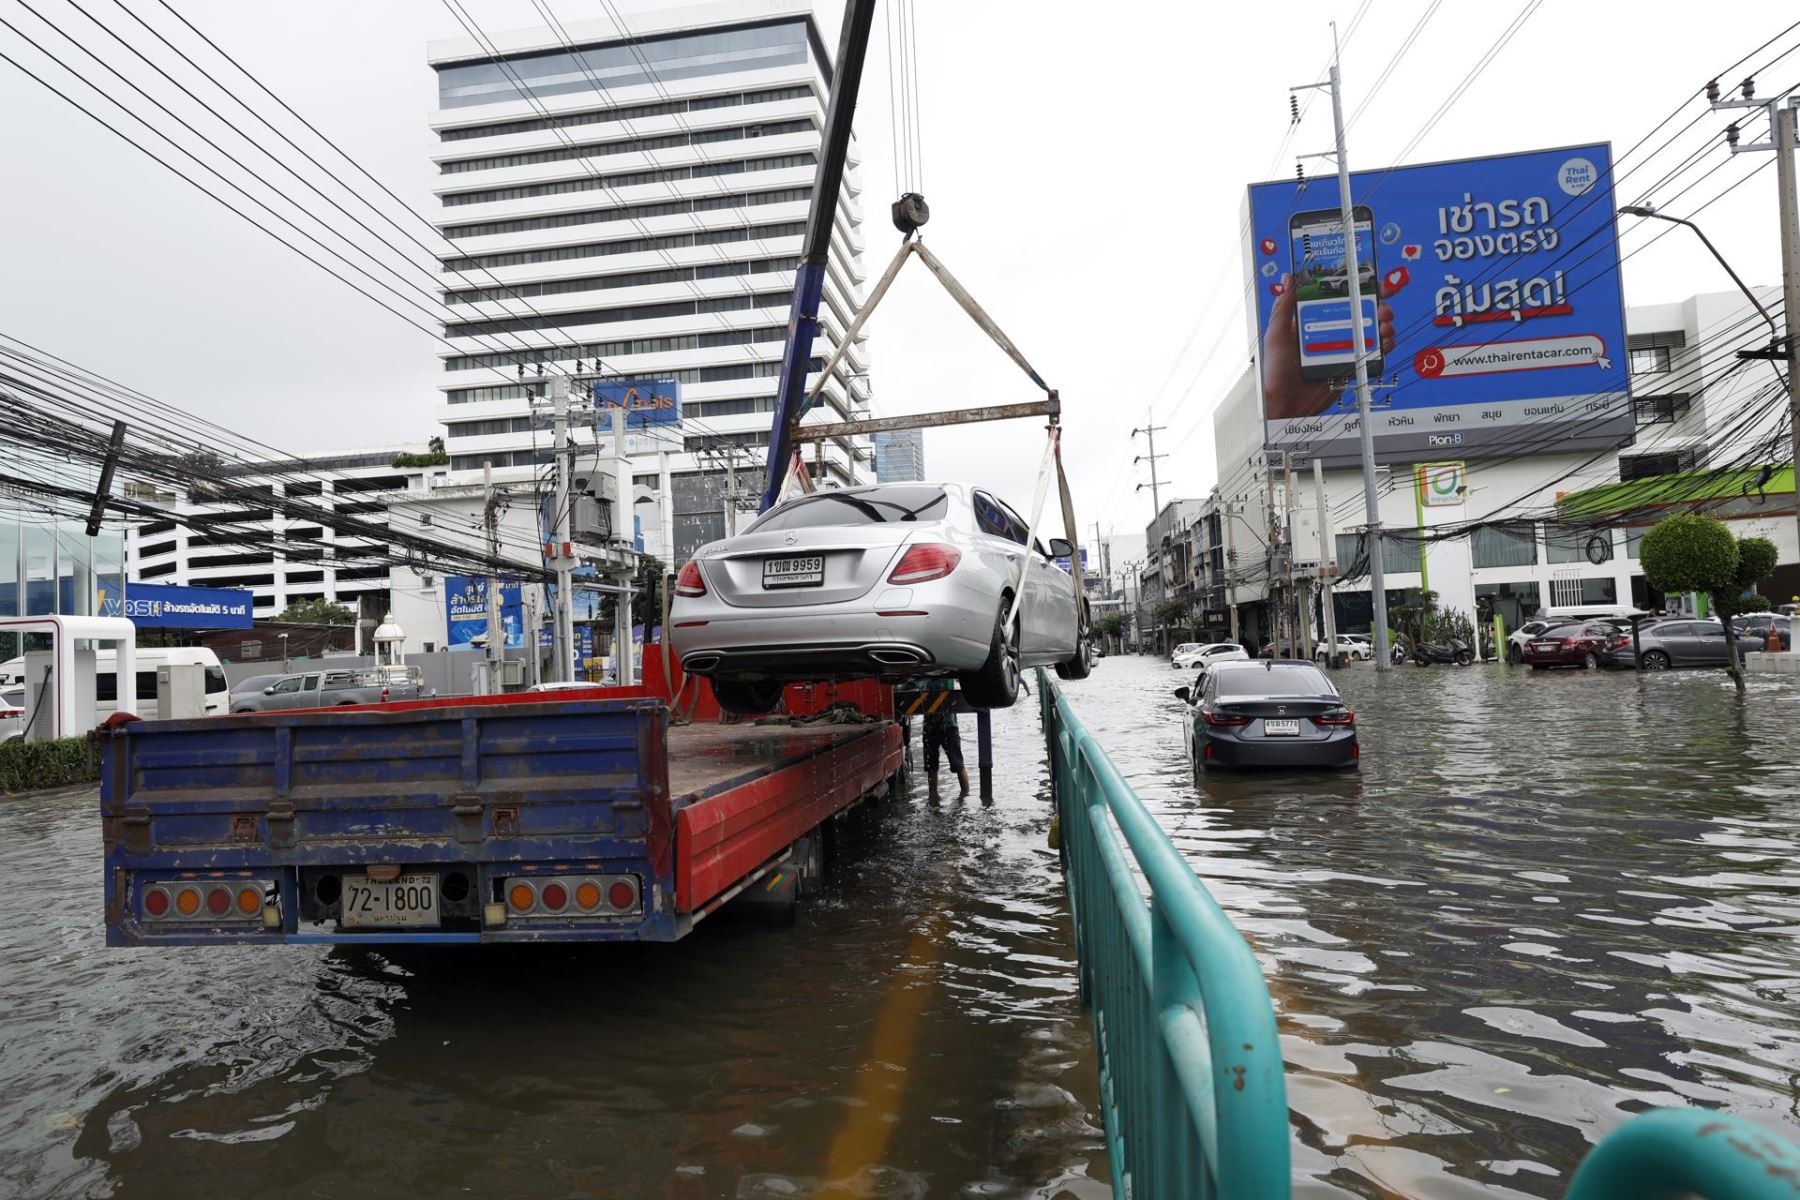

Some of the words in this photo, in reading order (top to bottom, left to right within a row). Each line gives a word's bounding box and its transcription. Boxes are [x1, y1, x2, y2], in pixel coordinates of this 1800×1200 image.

[1438, 192, 1549, 234] เช่ารถ
[1434, 228, 1559, 261] จองตรง
[1435, 270, 1566, 327] คุ้มสุด!
[1453, 345, 1592, 366] www.thairentacar.com
[1388, 417, 1414, 427] หัวหิน
[1434, 413, 1460, 423] พัทยา
[793, 559, 820, 571] 9959
[349, 886, 432, 912] 72-1800
